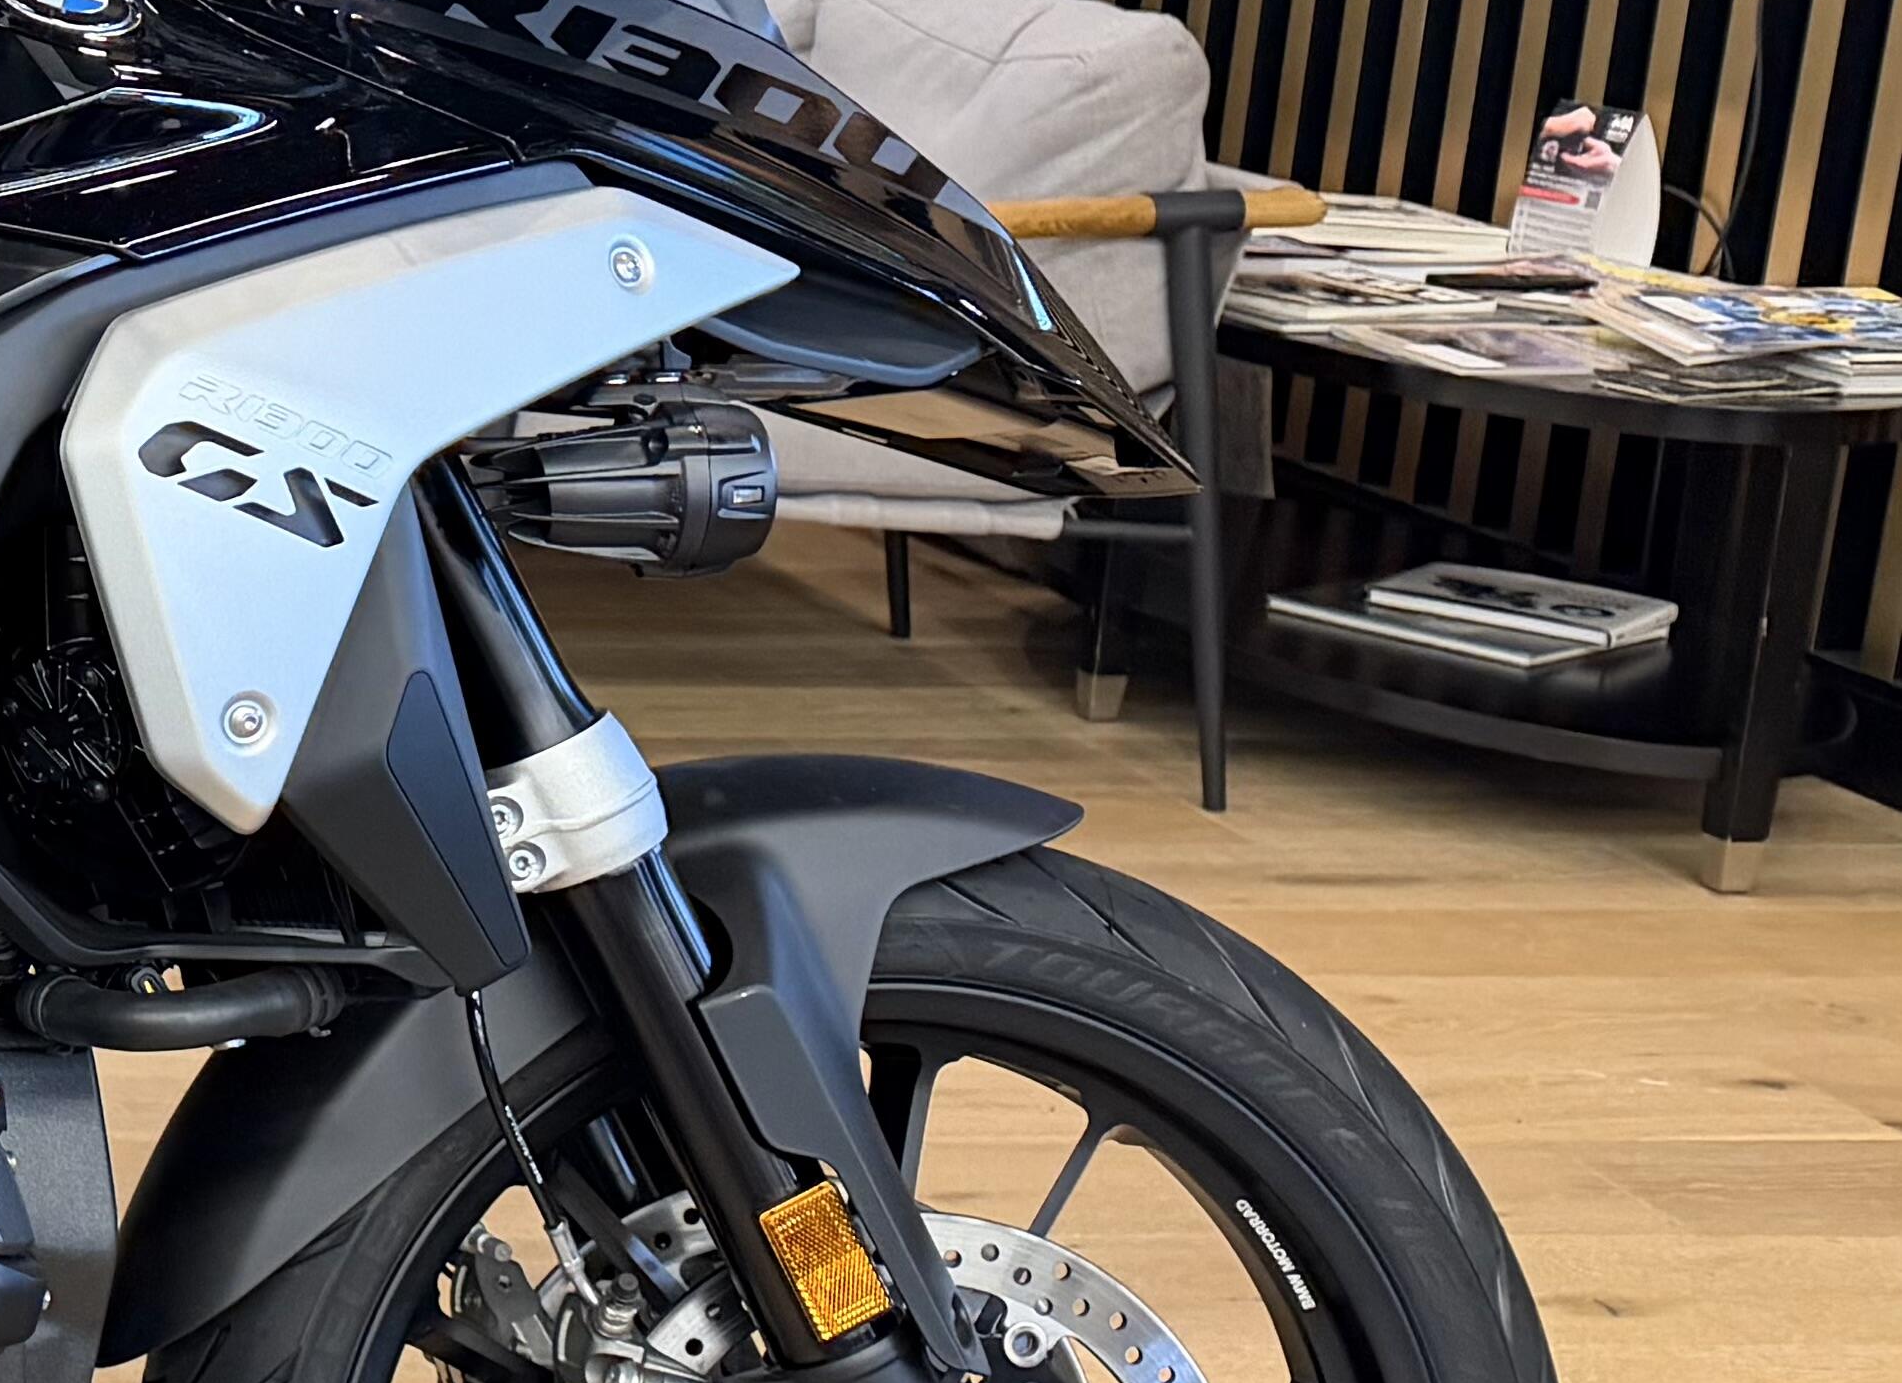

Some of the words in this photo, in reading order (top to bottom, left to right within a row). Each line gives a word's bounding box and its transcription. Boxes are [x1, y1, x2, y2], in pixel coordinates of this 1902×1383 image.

[178, 375, 394, 480] R1300
[137, 420, 380, 549] GS
[1236, 1199, 1296, 1273] MOTORRAD
[1286, 1273, 1317, 1311] BMW
